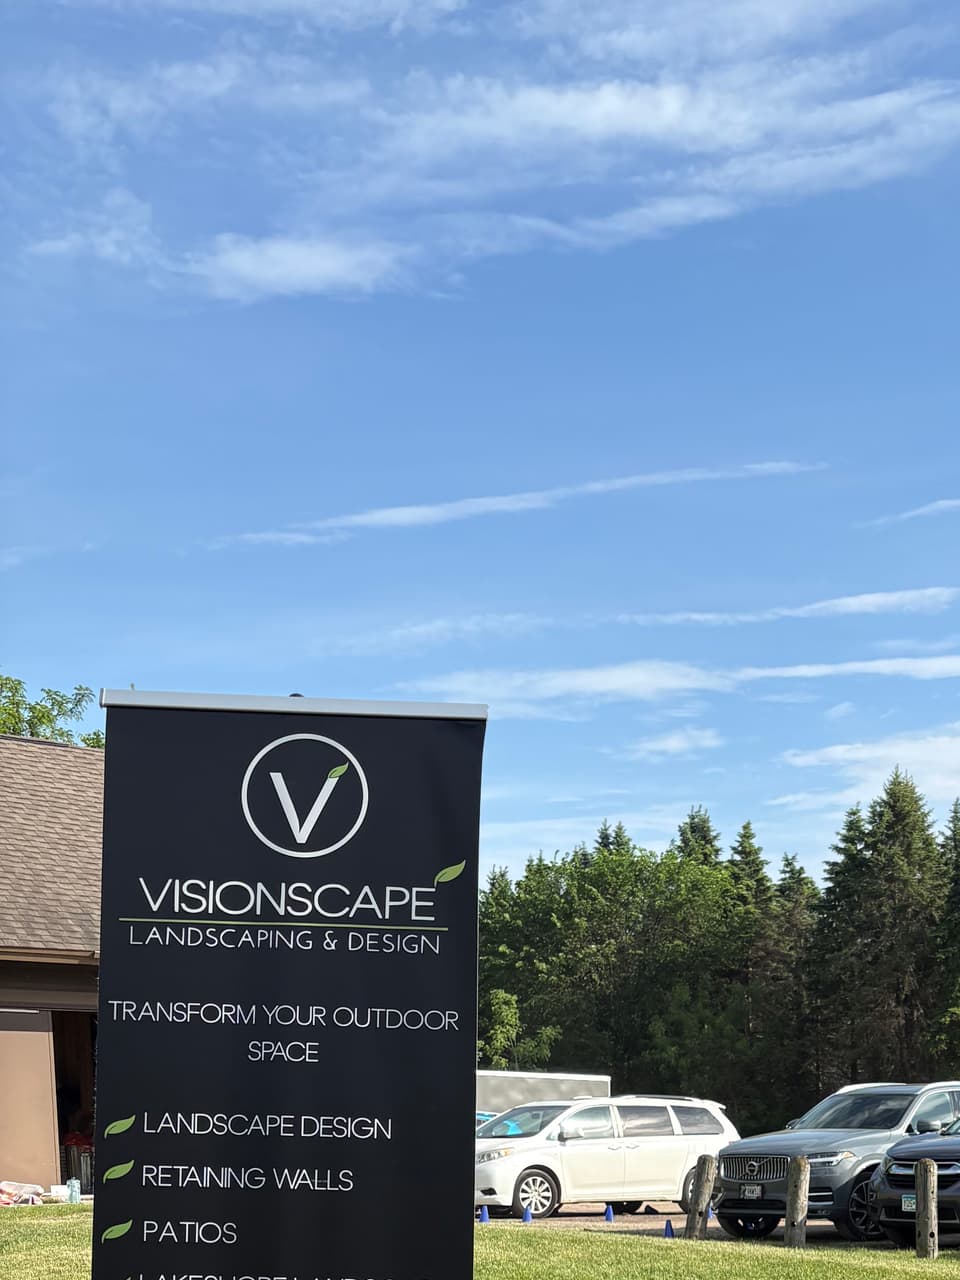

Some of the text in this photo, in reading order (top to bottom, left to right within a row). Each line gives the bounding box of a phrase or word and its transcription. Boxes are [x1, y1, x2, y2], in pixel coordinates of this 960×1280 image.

[138, 877, 436, 921] VISIONSCAPE
[129, 925, 440, 955] LANDSCAPING & DESIGN
[108, 1000, 459, 1031] TRANSFORM YOUR OUTDOOR
[247, 1040, 320, 1063] SPACE
[143, 1111, 392, 1140] LANDSCAPE DESIGN
[142, 1164, 354, 1192] RETAINING WALLS
[142, 1220, 237, 1244] PATIOS
